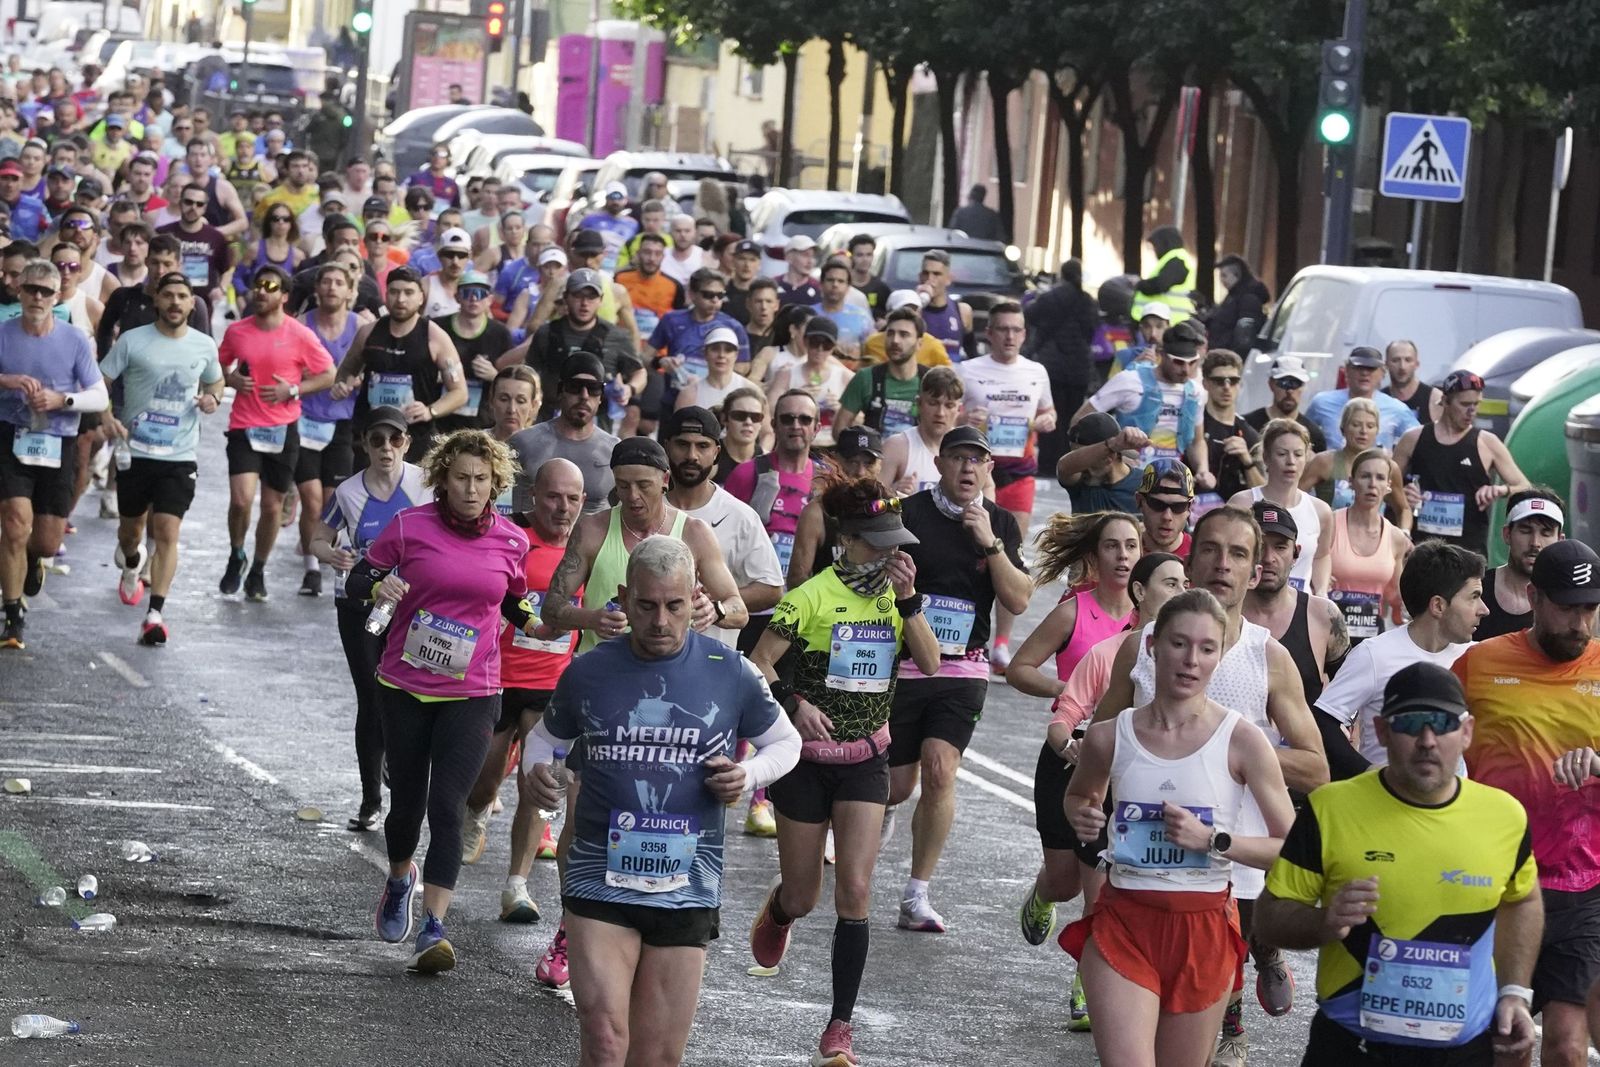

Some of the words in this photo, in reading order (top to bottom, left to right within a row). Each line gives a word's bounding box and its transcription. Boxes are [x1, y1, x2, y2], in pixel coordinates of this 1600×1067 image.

[935, 599, 969, 612] ZURICH
[933, 615, 952, 625] 9513
[857, 629, 891, 639] ZURICH
[930, 626, 960, 641] VITO
[428, 635, 453, 651] 14762
[418, 645, 452, 666] RUTH
[855, 650, 876, 659] 8645
[851, 662, 877, 676] FITO
[616, 725, 700, 745] MEDIA
[641, 817, 689, 830] ZURICH
[640, 841, 667, 854] 9358
[1141, 847, 1185, 864] JUJU
[621, 855, 681, 873] RUBIÑO
[1403, 946, 1460, 963] ZURICH
[1402, 975, 1433, 990] 6532
[1361, 992, 1399, 1012] PEPE
[1404, 1000, 1465, 1019] PRADOS
